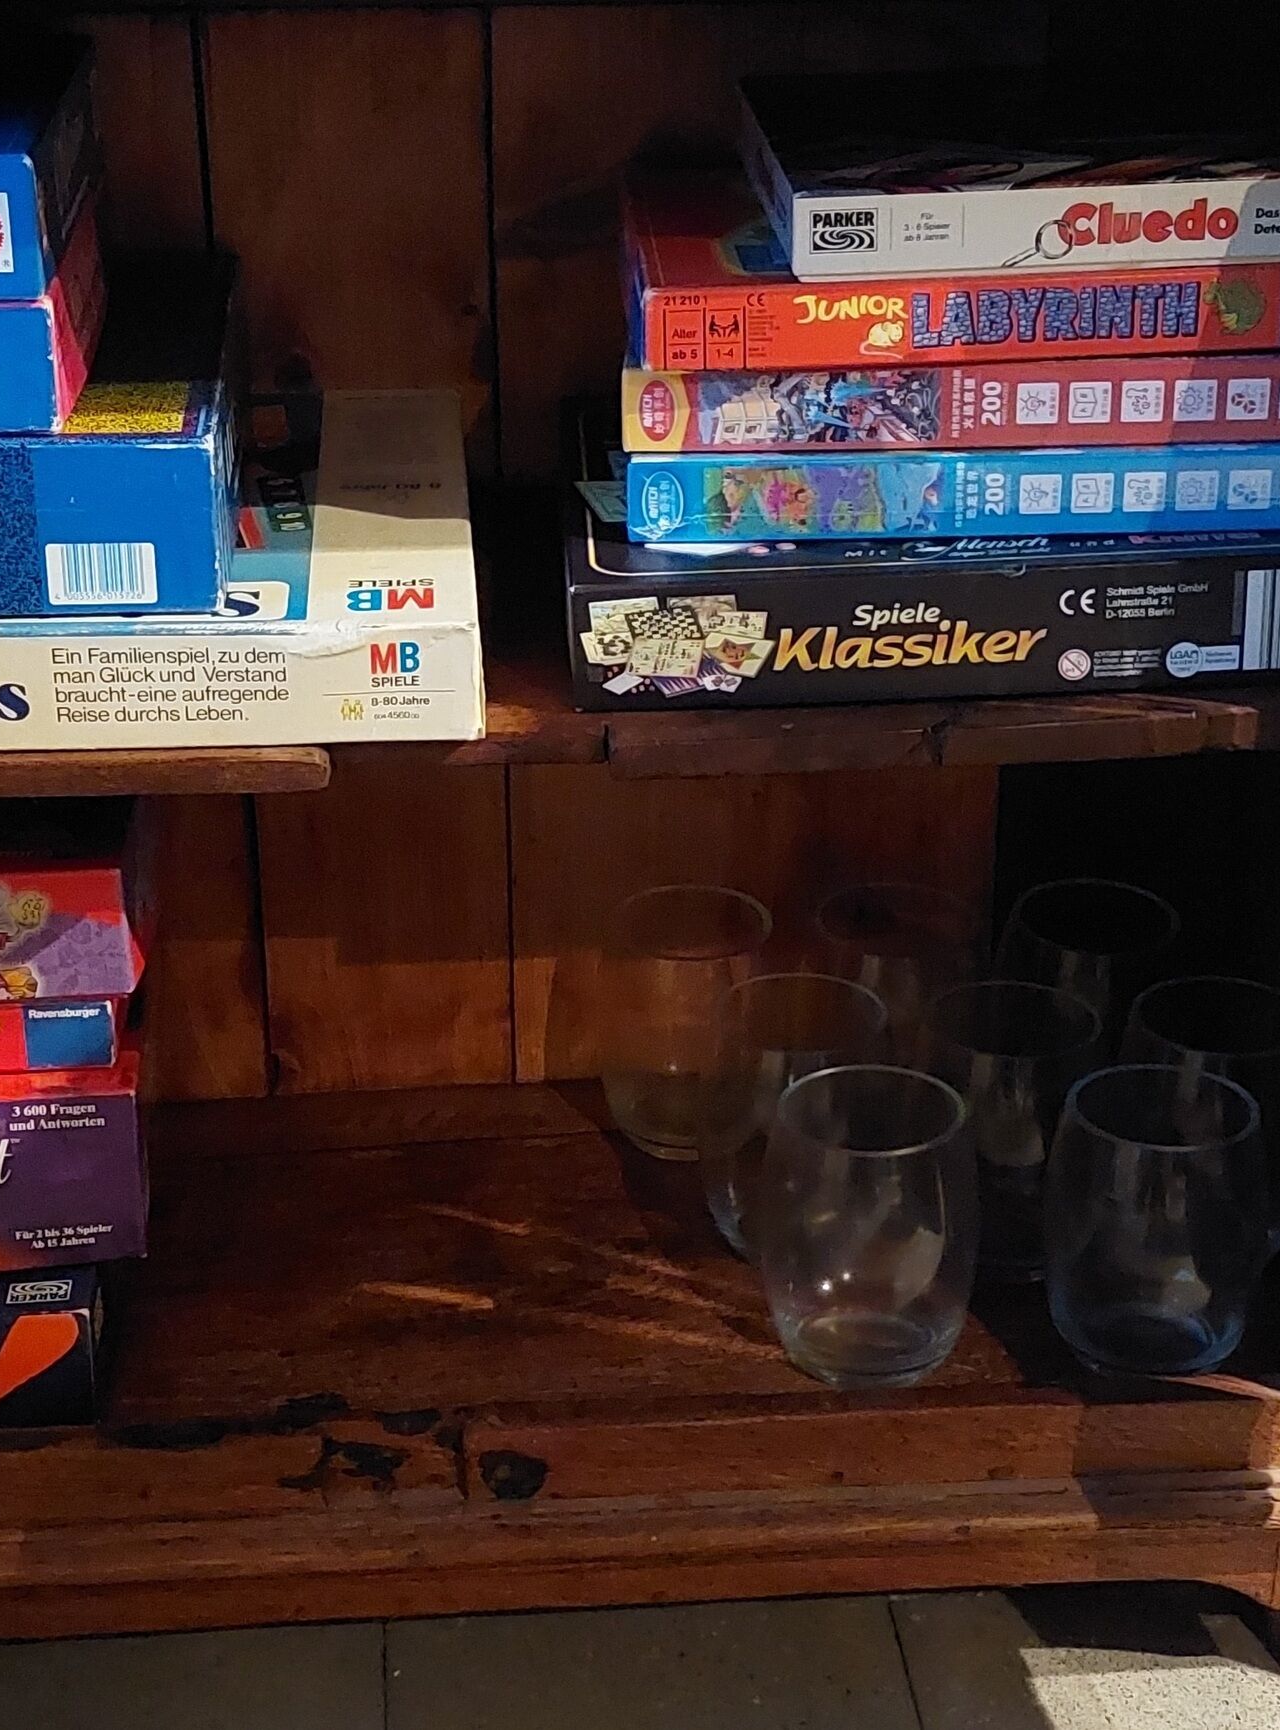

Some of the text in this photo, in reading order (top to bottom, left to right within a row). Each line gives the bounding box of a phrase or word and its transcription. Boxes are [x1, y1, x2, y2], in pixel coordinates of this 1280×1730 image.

[812, 211, 875, 229] PARKER
[1255, 208, 1280, 219] Das
[1057, 197, 1239, 247] Cluedo
[663, 296, 677, 306] 21
[679, 296, 701, 306] 210
[746, 293, 765, 307] CE
[793, 281, 1201, 350] JUNIOR LABYRINTH
[671, 327, 698, 340] Alter
[672, 348, 698, 360] ab 5
[715, 347, 734, 360] 1-4
[980, 381, 1002, 426] 200
[984, 473, 1005, 516] 200
[348, 578, 435, 588] SPIELE
[1106, 583, 1209, 597] Schmidt Spiele GmbH
[347, 588, 435, 612] MB
[1058, 588, 1096, 616] CE
[1161, 596, 1173, 606] 21
[852, 602, 941, 631] Spiele
[1147, 607, 1176, 617] Berlin
[772, 619, 1048, 672] Klassiker
[51, 646, 286, 667] Ein Familienspiel, zu dem
[370, 642, 420, 674] MB
[53, 666, 287, 684] man Glück und Verstand
[371, 676, 420, 688] SPIELE
[181, 685, 289, 705] aufregende
[398, 695, 431, 706] Jahre
[56, 704, 250, 723] Reise durchs Leben.
[27, 1007, 102, 1020] Ravensburger
[11, 1103, 96, 1118] 3 600 Fragen
[9, 1116, 106, 1132] und Antworten
[15, 1222, 114, 1241] Für 2 bis 36 Spieler
[30, 1236, 96, 1250] Ab 15 Jahren
[10, 1291, 68, 1303] PARKER
